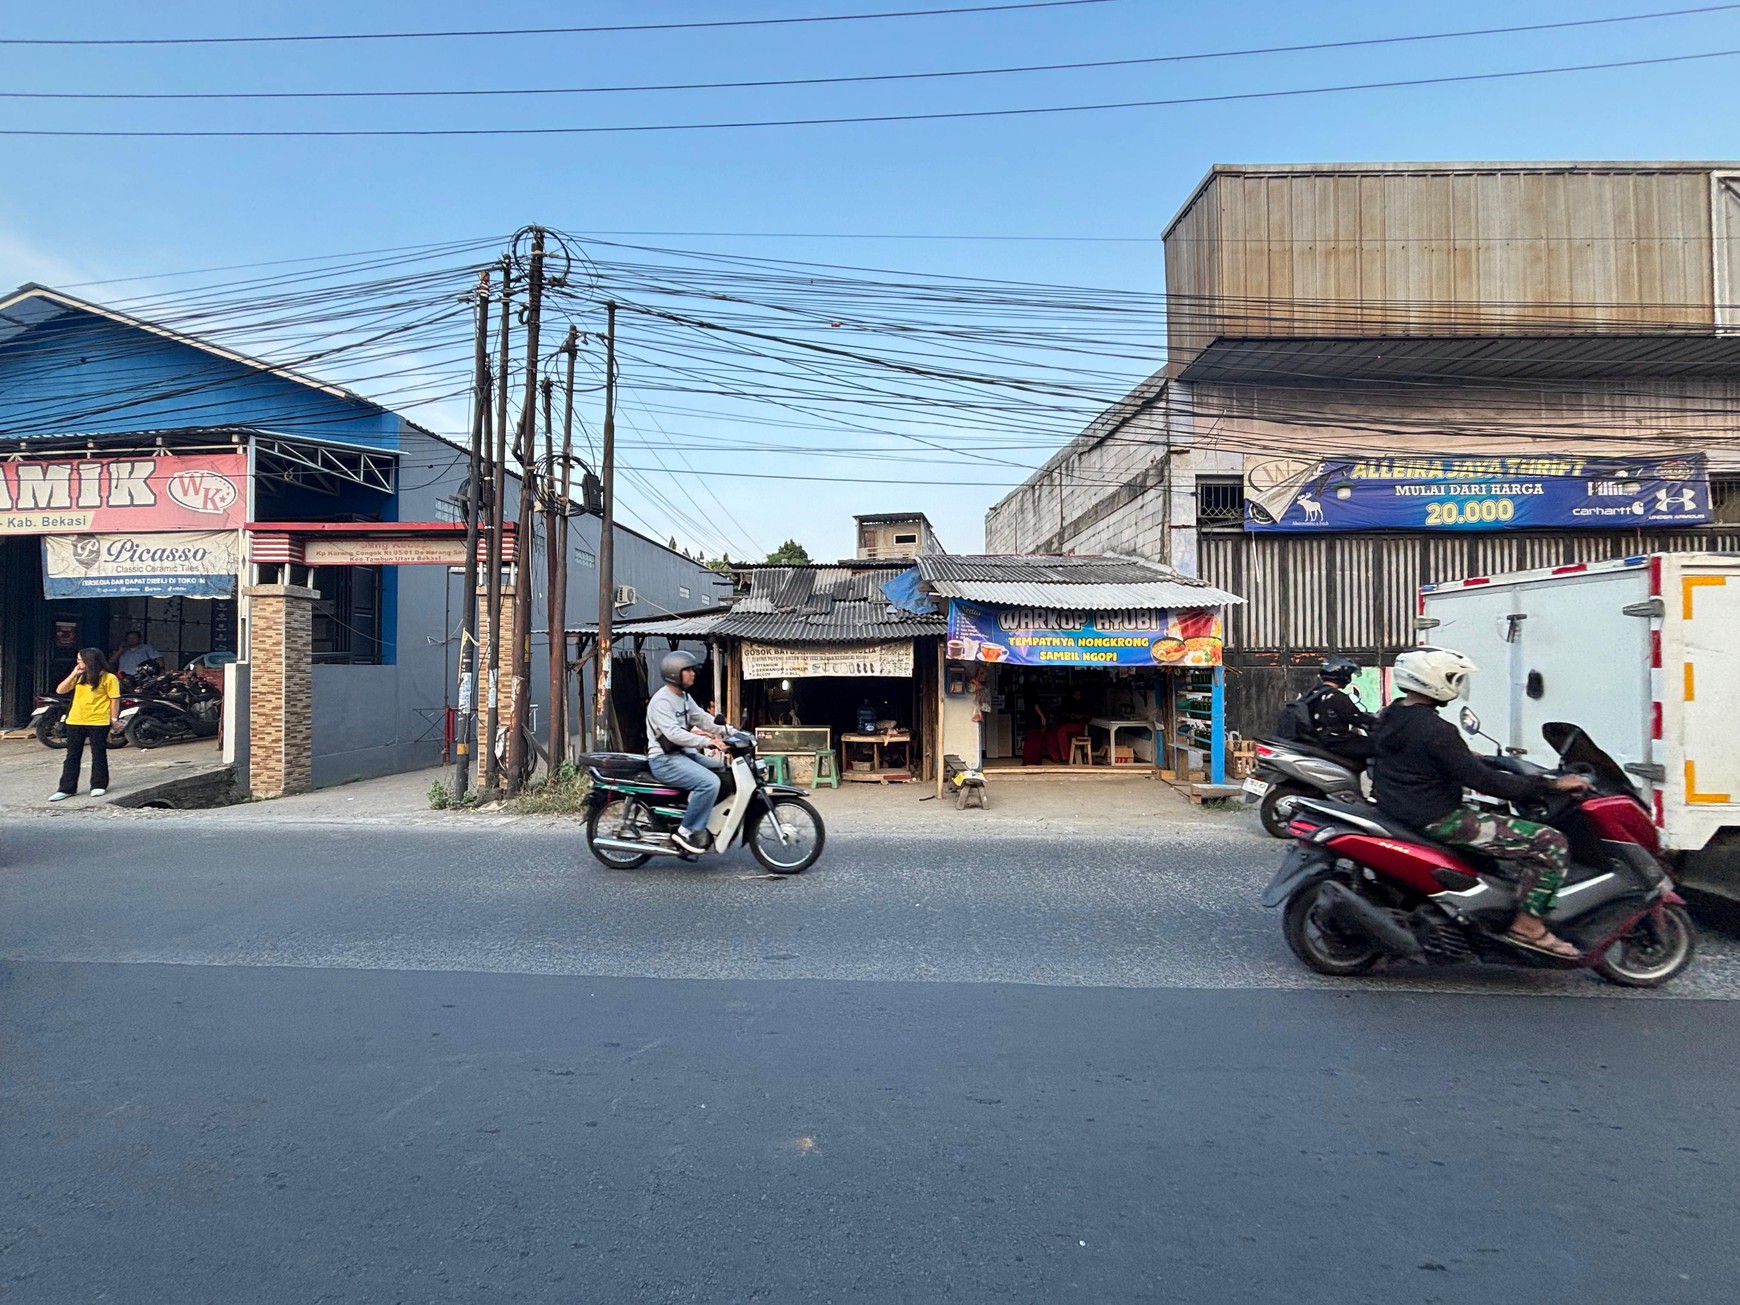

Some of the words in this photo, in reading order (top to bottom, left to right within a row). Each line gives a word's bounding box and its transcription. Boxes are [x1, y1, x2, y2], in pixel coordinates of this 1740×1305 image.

[1395, 485, 1446, 496] MULAI
[1450, 484, 1487, 495] DARI
[1490, 483, 1544, 495] HARGA
[1425, 498, 1515, 526] 20.000
[1572, 507, 1632, 516] carhartt
[7, 517, 37, 528] Kab.
[41, 515, 87, 527] Bekasi
[103, 538, 207, 564] Picasso
[116, 564, 143, 573] Classic
[145, 564, 178, 573] Ceramic
[180, 564, 200, 572] Tiles
[998, 607, 1089, 631] WARKOP
[1092, 607, 1160, 631] AYUBI
[1008, 636, 1075, 648] TEMPATNYA
[1077, 636, 1149, 648] NONGKRONG
[744, 648, 772, 657] GOSOK
[1039, 651, 1080, 662] SAMBIL
[1082, 651, 1118, 662] NGOPI
